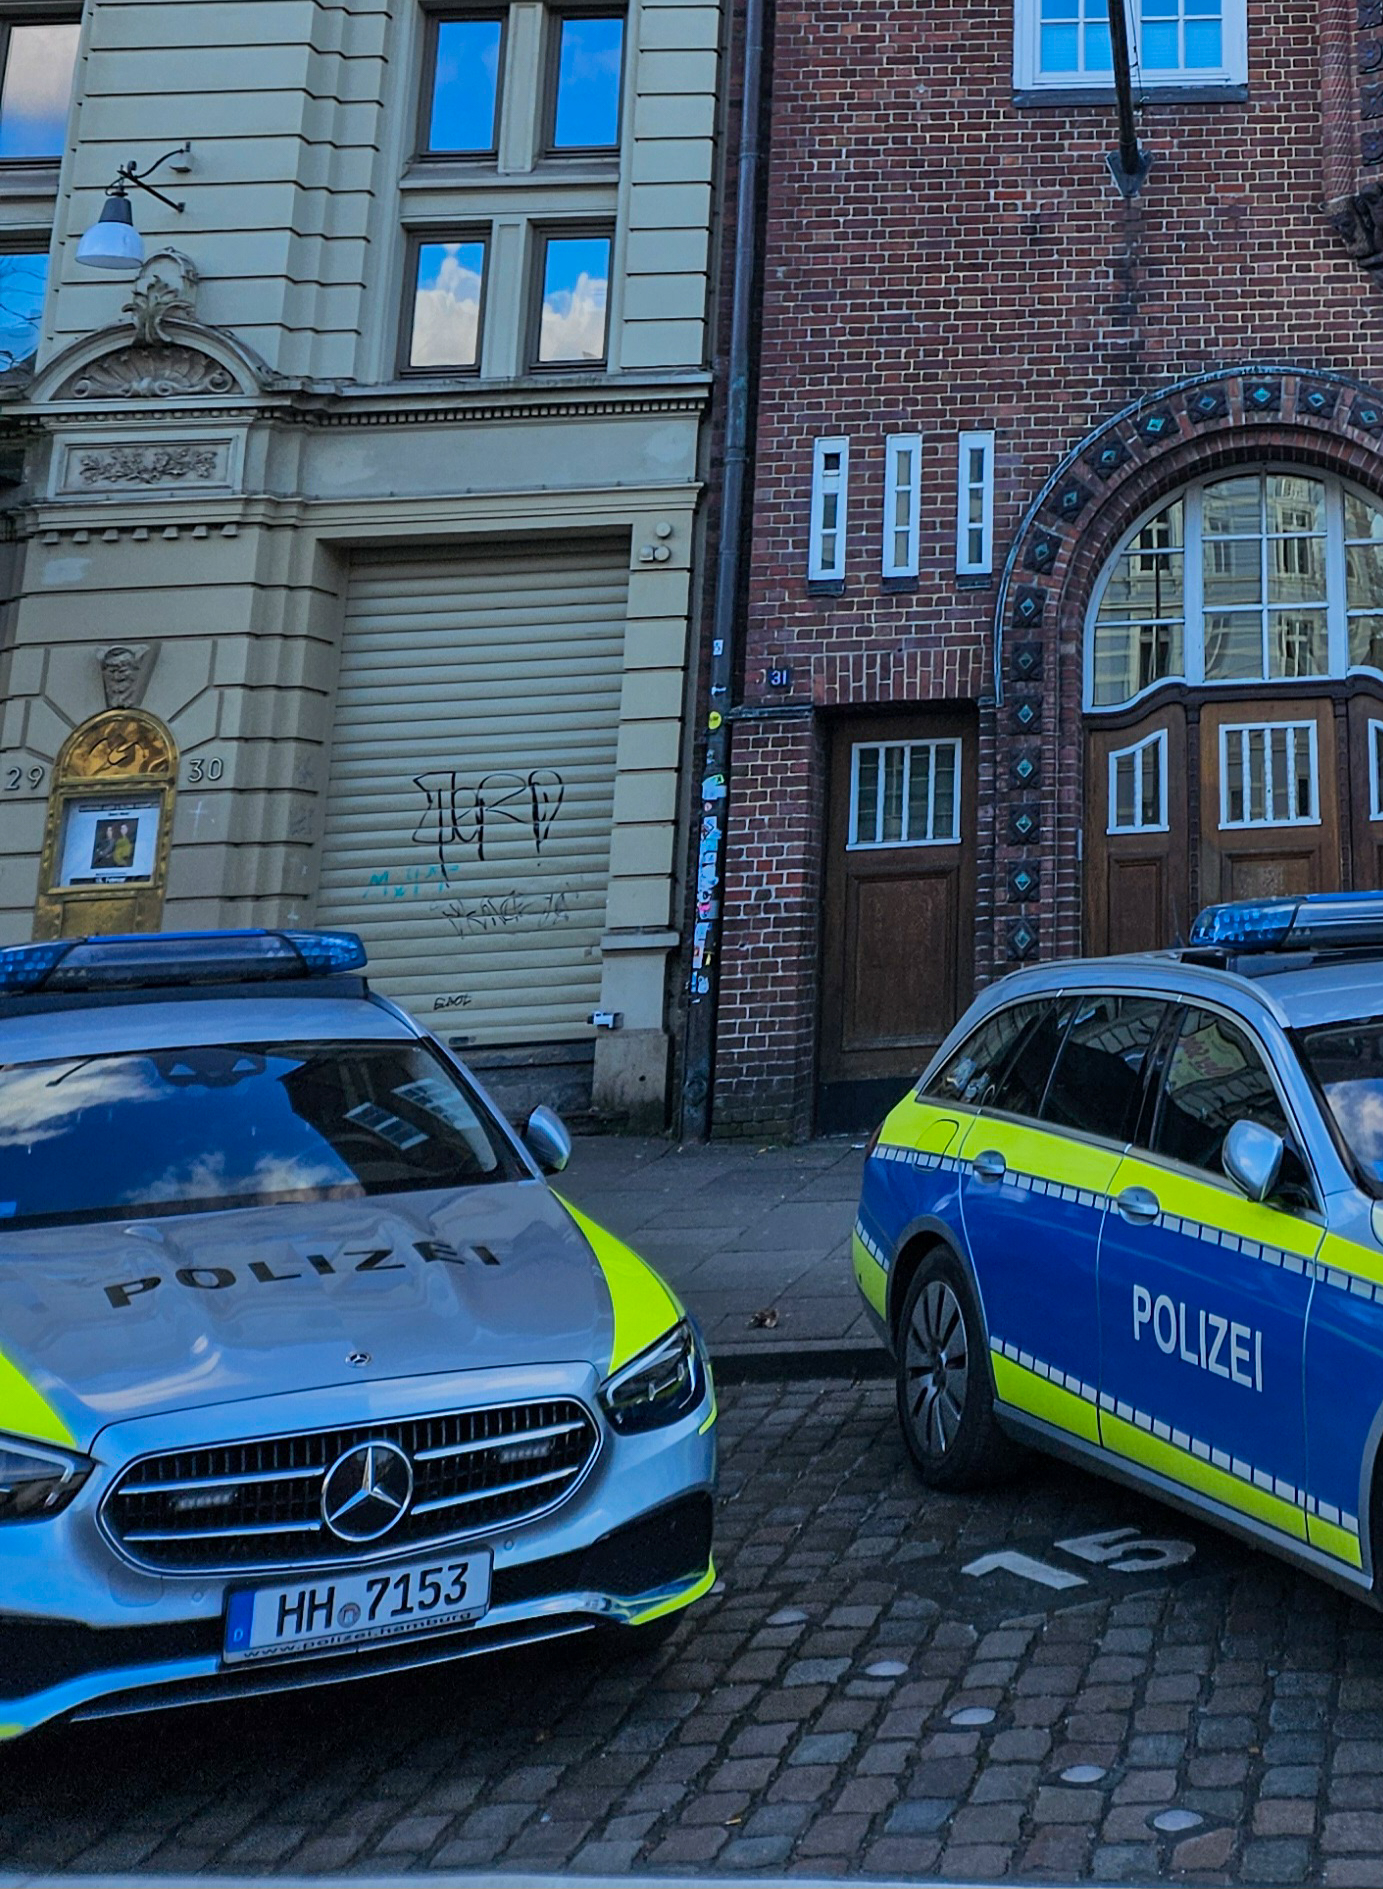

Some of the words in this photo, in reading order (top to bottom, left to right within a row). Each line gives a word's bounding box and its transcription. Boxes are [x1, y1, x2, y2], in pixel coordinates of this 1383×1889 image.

[4, 765, 46, 792] 29
[187, 758, 224, 783] 30
[103, 1240, 501, 1309] POLIZEI
[1133, 1283, 1263, 1393] POLIZEI
[960, 1526, 1197, 1590] 15
[233, 1628, 244, 1642] D
[275, 1585, 336, 1638] HH
[366, 1561, 470, 1622] 7153
[243, 1611, 473, 1658] www.polizei.hamburg
